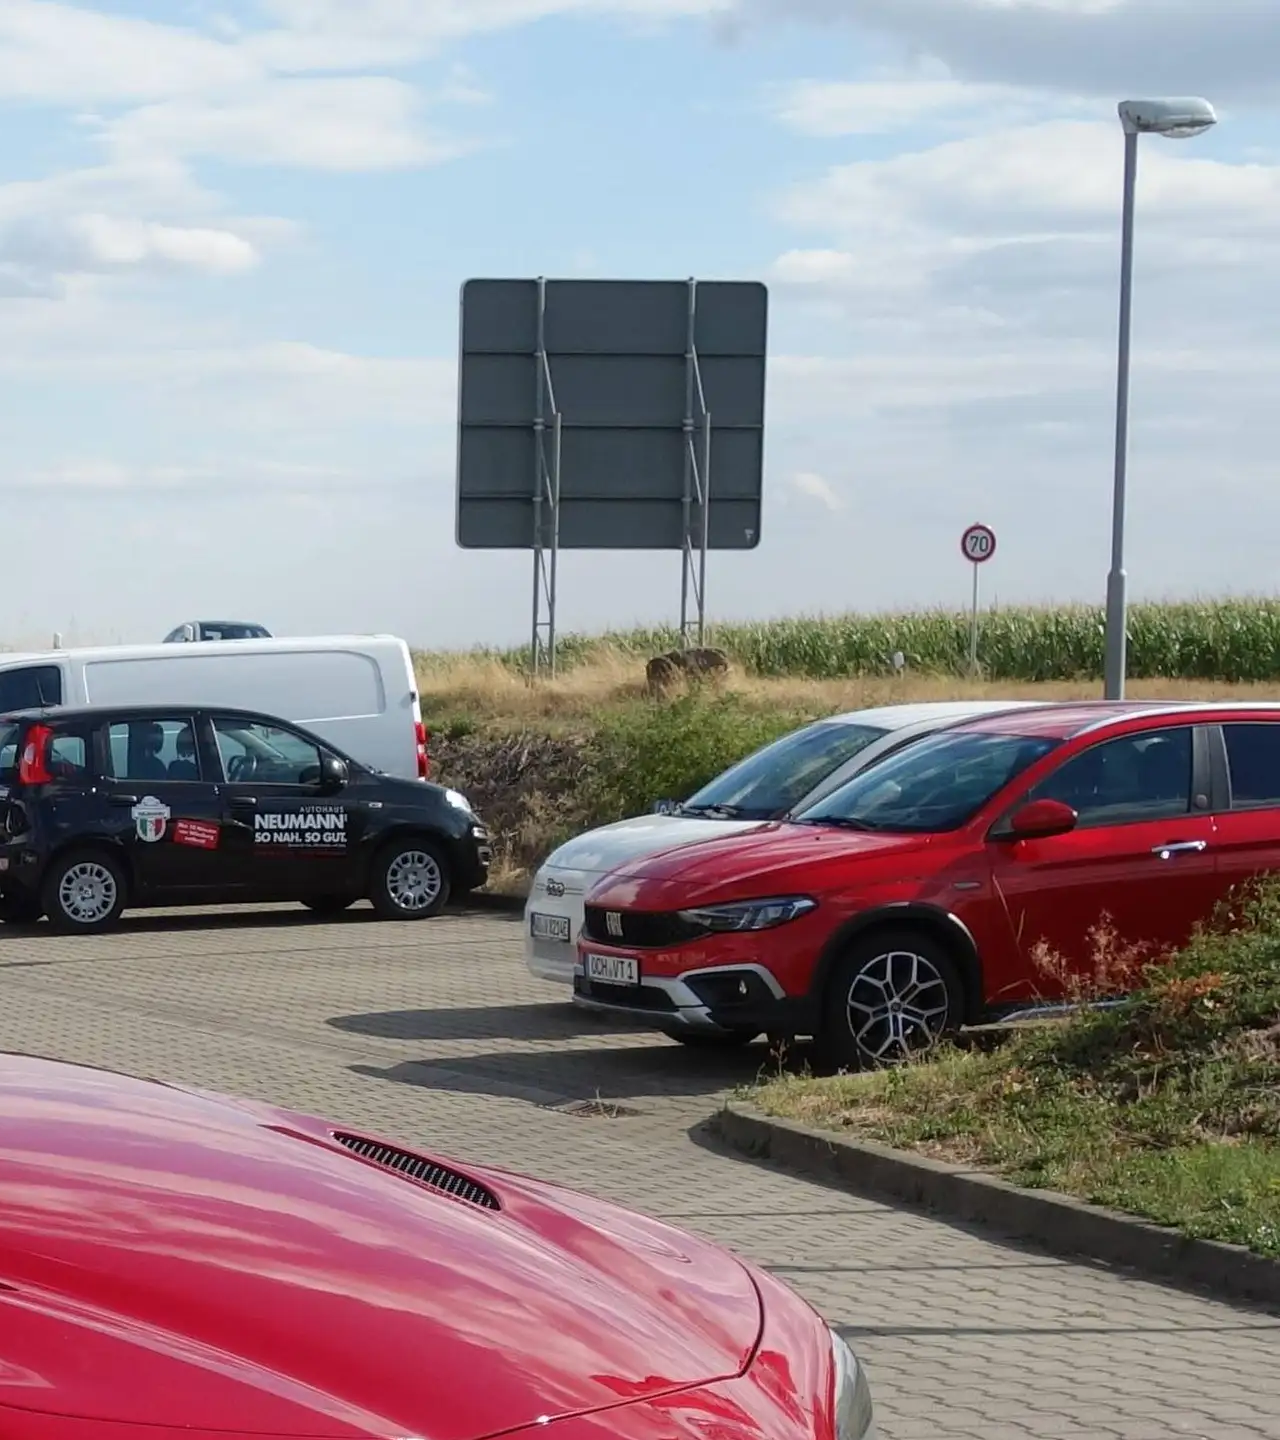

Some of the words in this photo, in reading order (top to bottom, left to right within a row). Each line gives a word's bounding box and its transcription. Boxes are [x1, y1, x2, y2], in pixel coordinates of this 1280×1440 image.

[970, 535, 989, 552] 70
[254, 814, 345, 829] NEUMANN
[254, 831, 271, 842] SO
[273, 832, 302, 842] NAH.
[305, 832, 321, 842] SO
